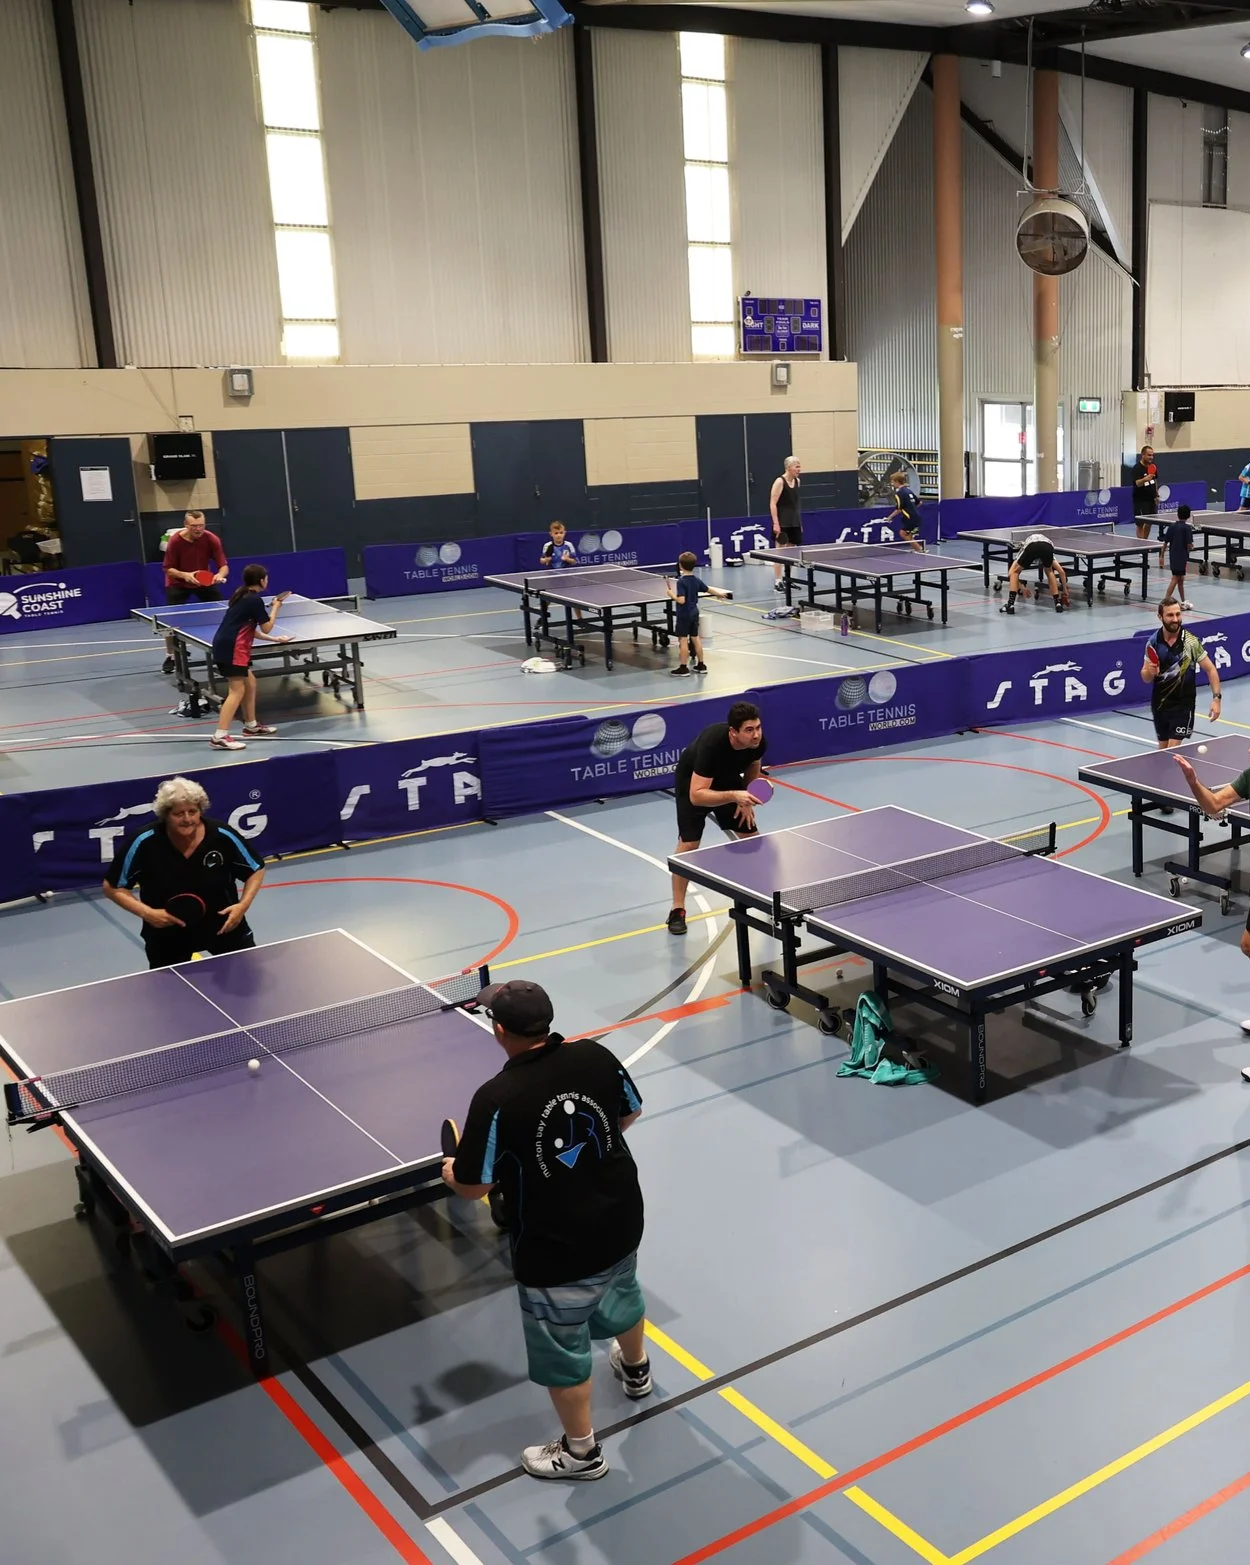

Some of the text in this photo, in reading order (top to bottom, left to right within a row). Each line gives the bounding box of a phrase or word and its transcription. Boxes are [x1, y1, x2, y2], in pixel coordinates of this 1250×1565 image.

[575, 555, 600, 564] ABLE
[601, 551, 637, 563] TENNIS
[404, 564, 478, 580] TABLE TENNIS
[21, 588, 82, 604] SUNSHINE
[22, 600, 64, 613] COAST
[987, 670, 1125, 709] STAG
[819, 704, 916, 730] TABLE TENNIS
[869, 716, 916, 731] WORLD.COM
[571, 747, 687, 780] TABLE TENNI
[633, 763, 679, 779] WORLD.C
[340, 771, 482, 820] STA
[1167, 920, 1195, 936] XIOM
[933, 979, 960, 997] XIOM
[541, 1098, 557, 1118] table
[556, 1091, 580, 1102] tennis
[581, 1095, 611, 1133] association
[243, 1274, 265, 1359] BOUNDPRO
